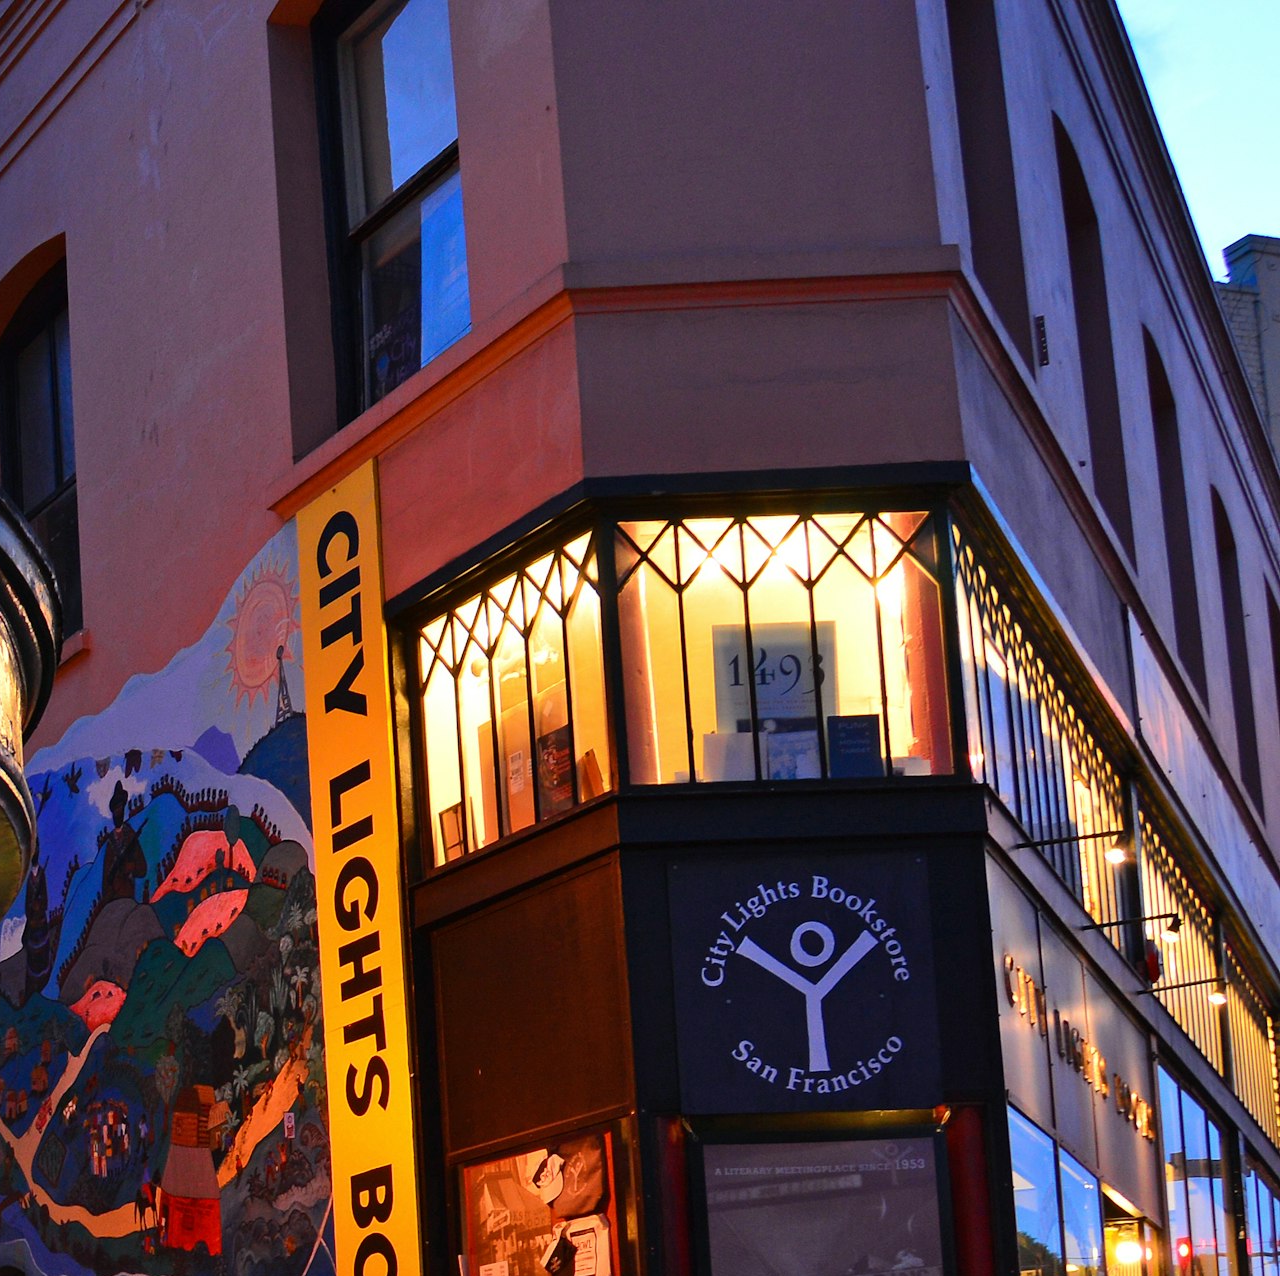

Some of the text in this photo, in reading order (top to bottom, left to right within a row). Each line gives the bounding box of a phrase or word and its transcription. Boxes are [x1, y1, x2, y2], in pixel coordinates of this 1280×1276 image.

[316, 511, 368, 717] CITY
[329, 759, 390, 1118] LIGHTS
[701, 875, 910, 988] City Lights Bookstore
[731, 1036, 903, 1094] San Francisco
[714, 1167, 722, 1177] A
[724, 1165, 773, 1177] LITERARY
[858, 1162, 892, 1172] SINCE
[894, 1158, 926, 1171] 1953
